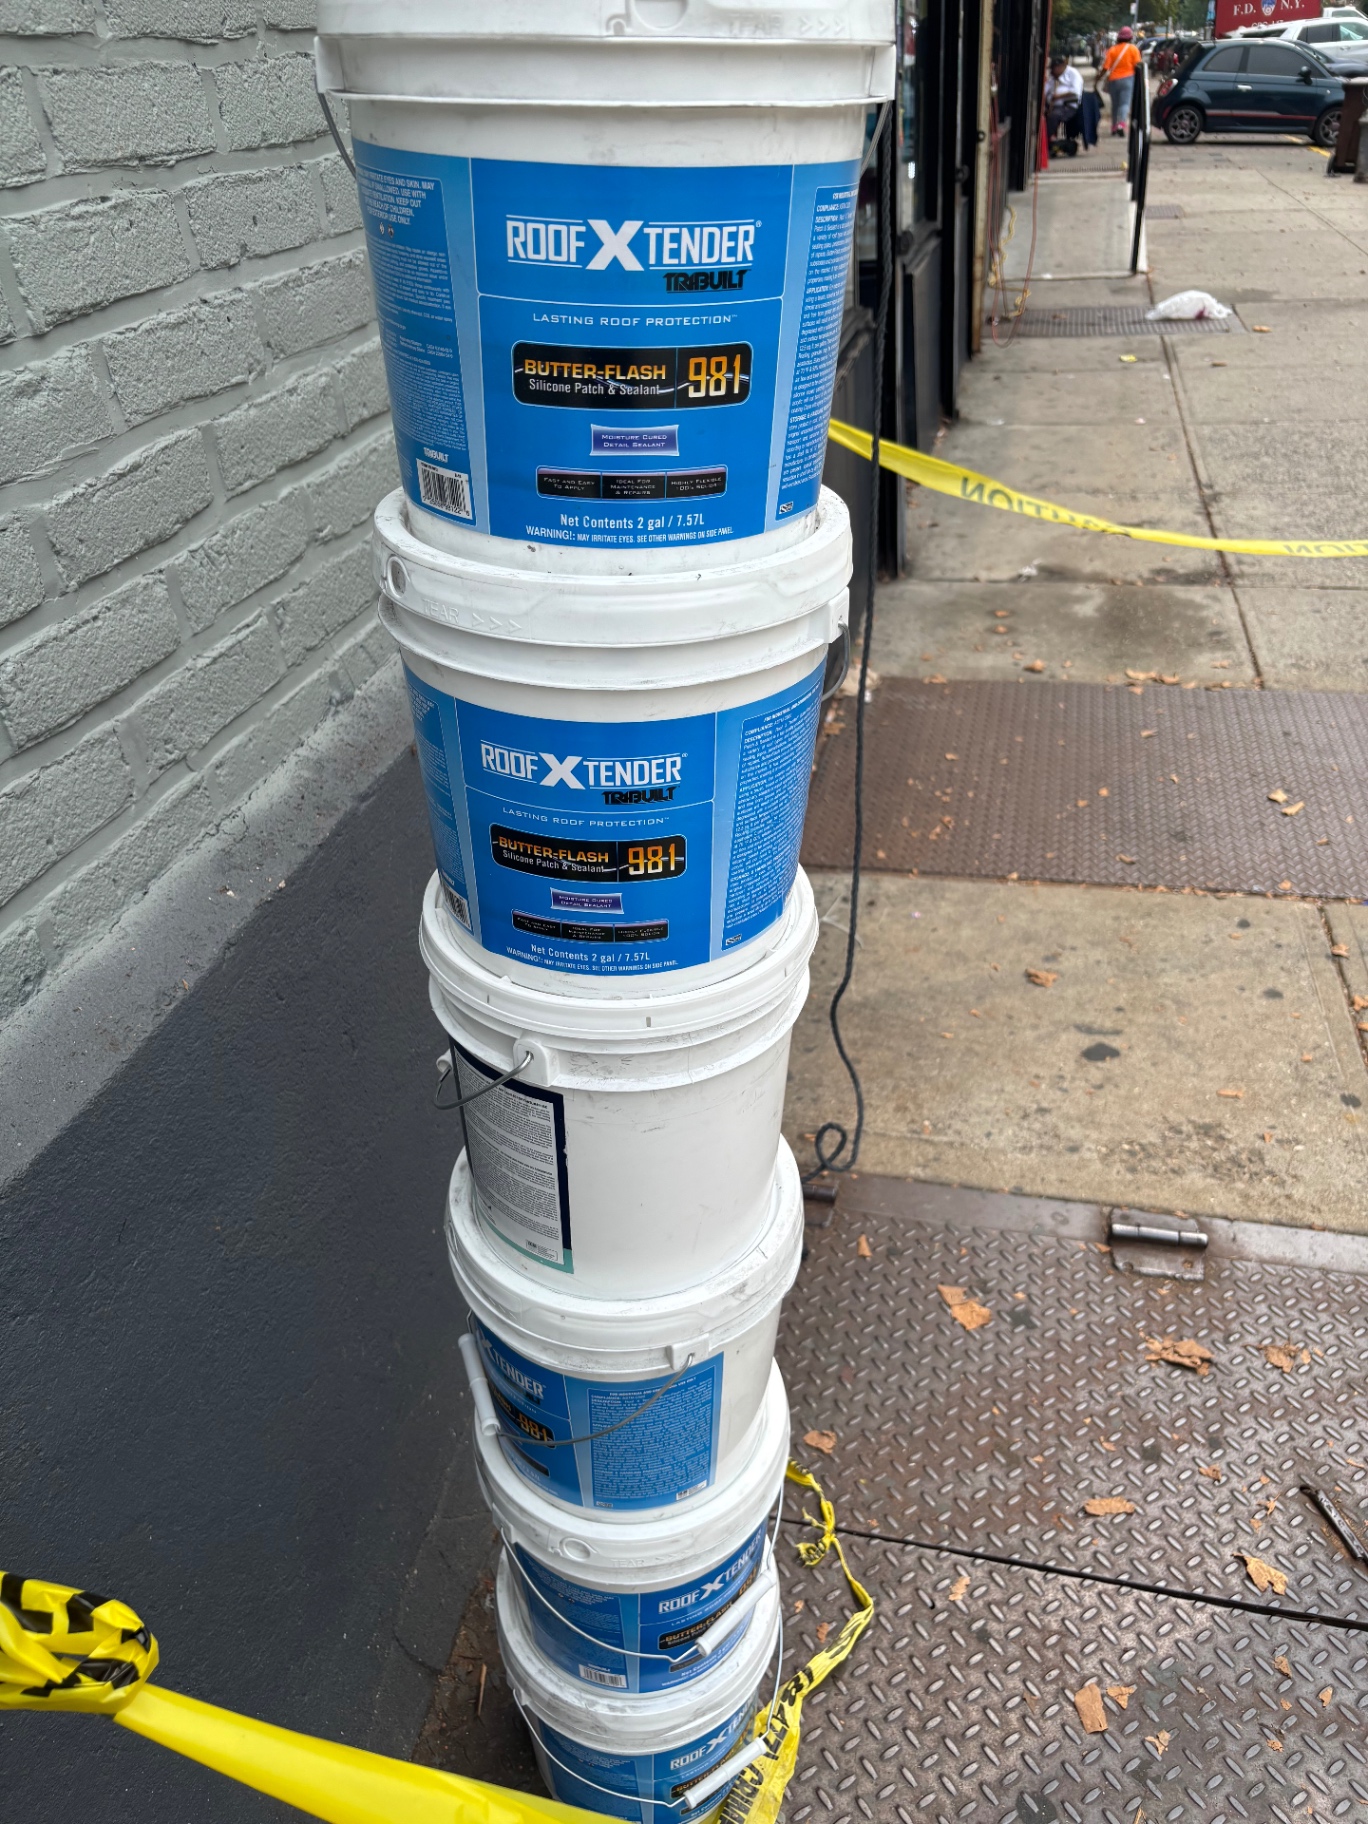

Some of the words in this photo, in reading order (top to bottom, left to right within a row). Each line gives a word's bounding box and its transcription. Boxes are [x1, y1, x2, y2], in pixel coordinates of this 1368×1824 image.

[1233, 2, 1257, 16] F.D.
[533, 312, 594, 326] LASTING
[600, 317, 640, 327] ROOF
[646, 315, 732, 327] PROTECTION
[524, 359, 666, 381] BUTTER-FLASH
[688, 354, 743, 399] 981
[529, 379, 571, 393] Silicone
[574, 382, 604, 395] Patch
[608, 384, 616, 396] &
[619, 384, 660, 396] Sealant
[560, 514, 579, 527] Net
[582, 516, 633, 529] Contents
[637, 516, 644, 529] 2
[647, 516, 665, 531] gal
[676, 513, 705, 527] 7.57L
[577, 533, 590, 542] MAY
[591, 534, 617, 543] IRRITATE
[619, 535, 635, 543] EYES.
[637, 534, 647, 543] SEE
[648, 534, 667, 543] OTHER
[667, 532, 697, 542] WARNINGS
[697, 531, 706, 539] ON
[706, 529, 718, 538] SIDE
[502, 807, 548, 822] LASTING
[553, 817, 585, 826] ROOF
[498, 836, 609, 863] BUTTER-FLASH
[628, 843, 676, 876] 981
[503, 850, 534, 866] Silicone
[536, 858, 560, 869] Patch
[562, 861, 568, 870] &
[571, 862, 605, 873] Sealant
[531, 943, 545, 954] Net
[548, 948, 589, 961] Contents
[592, 953, 597, 961] 2
[600, 953, 615, 963] gal
[625, 952, 650, 962] 7.57L
